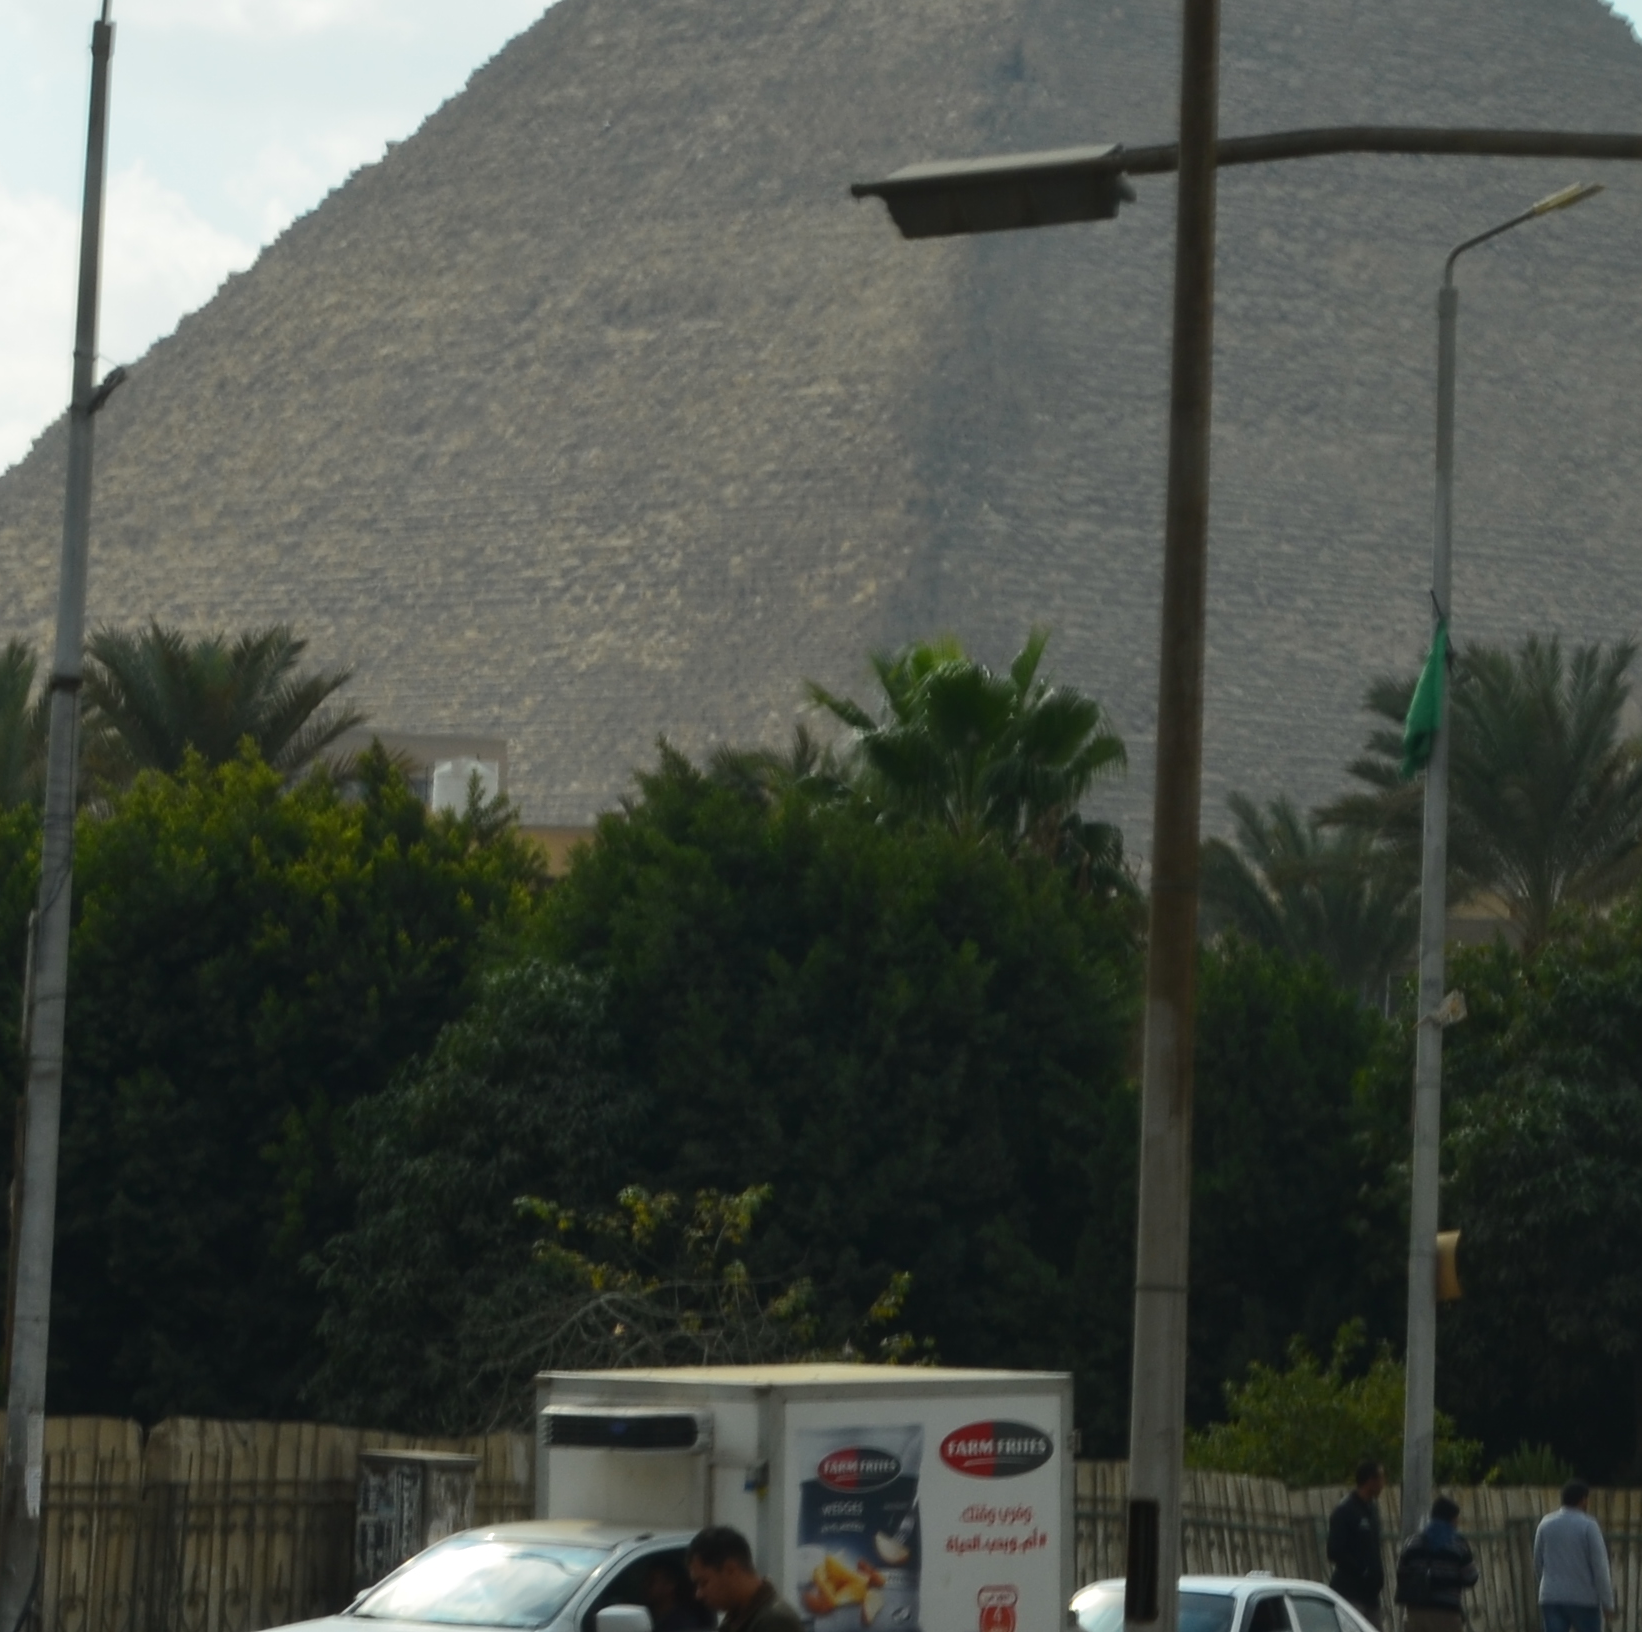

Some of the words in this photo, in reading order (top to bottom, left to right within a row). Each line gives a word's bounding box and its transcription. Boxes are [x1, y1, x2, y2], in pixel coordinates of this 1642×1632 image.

[946, 1439, 995, 1458] FARM
[996, 1436, 1047, 1456] FRITES
[822, 1460, 858, 1476] FARM
[858, 1458, 898, 1475] FRITES
